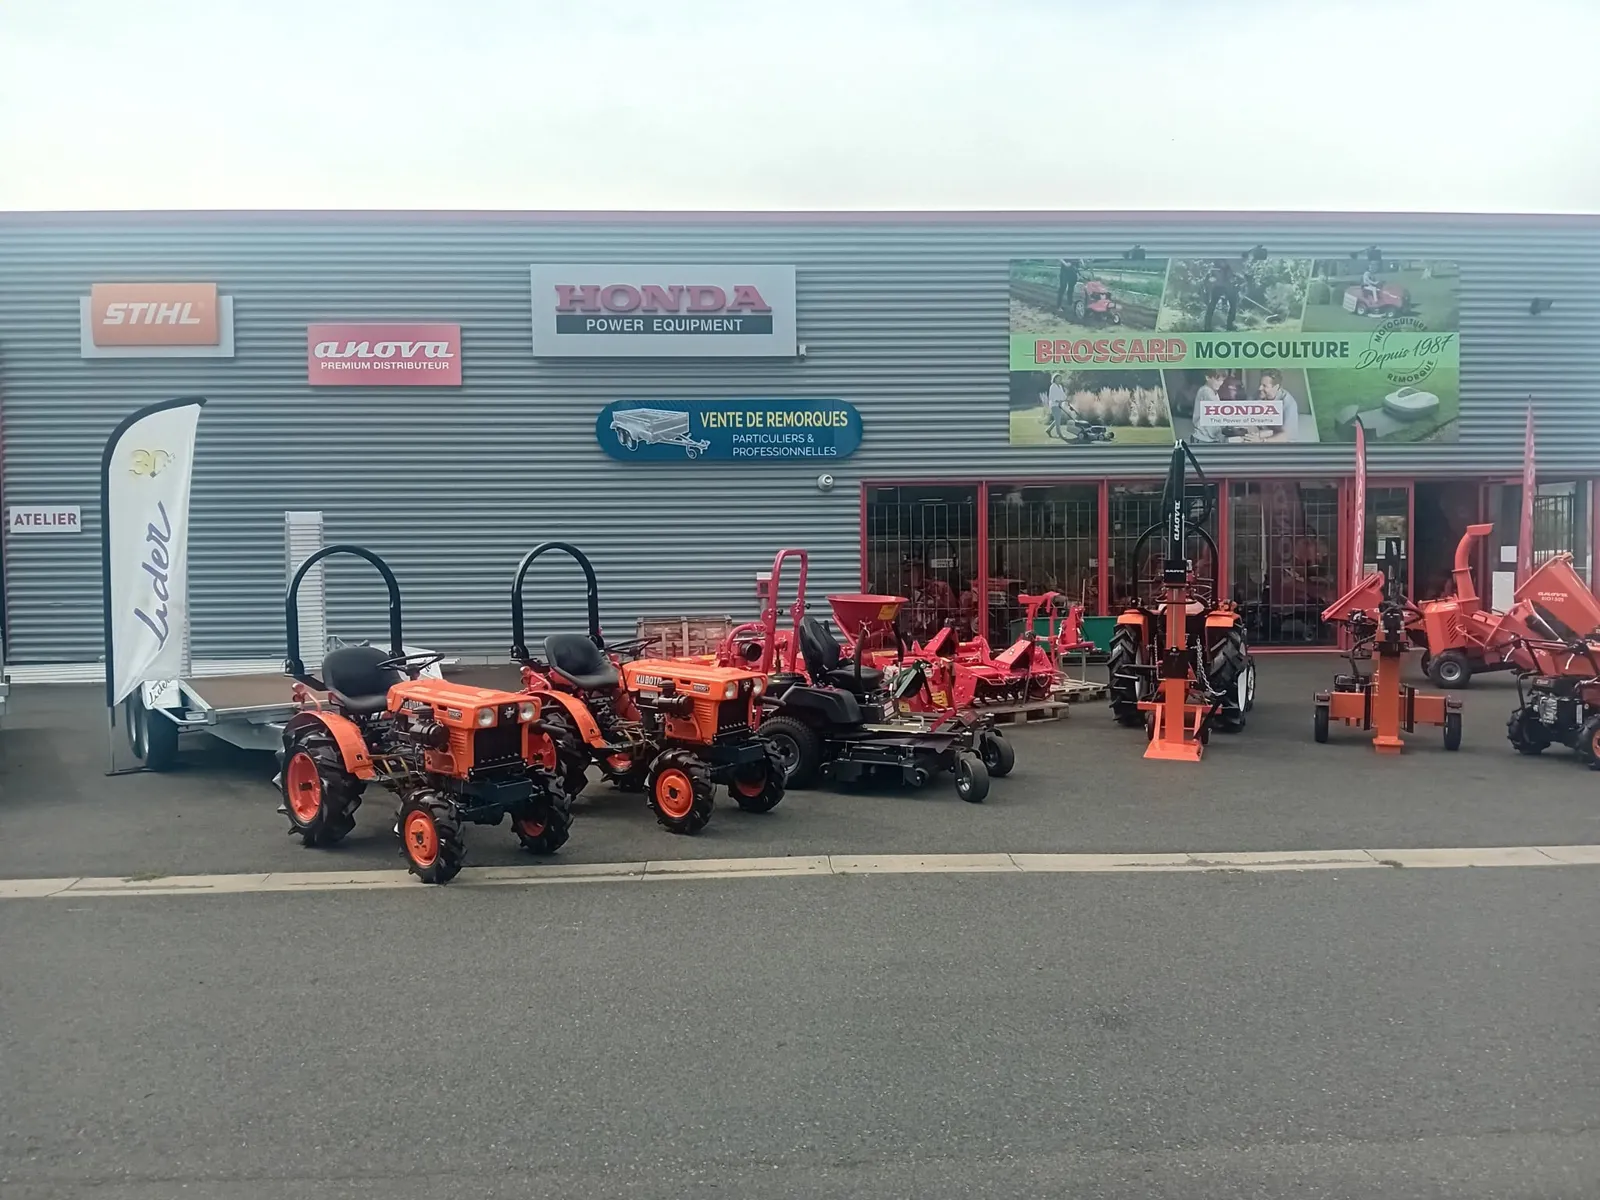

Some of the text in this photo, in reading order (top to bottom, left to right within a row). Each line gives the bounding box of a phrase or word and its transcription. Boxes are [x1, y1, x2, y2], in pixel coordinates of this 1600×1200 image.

[555, 284, 772, 312] HONDA
[102, 302, 200, 325] STIHL
[586, 319, 743, 332] POWER EQUIPMENT
[1374, 317, 1428, 343] MOTOCULTURE
[314, 340, 454, 358] anova
[1034, 338, 1349, 365] BROSSARD MOTOCULTURE
[1355, 333, 1454, 370] Depuis 1987
[320, 361, 450, 370] PREMIUM DISTRIBUTEUR
[1386, 360, 1434, 383] REMORQUE
[1204, 405, 1280, 415] HONDA
[700, 411, 848, 428] VENTE DE REMORQUES
[732, 434, 815, 444] PARTICULIERS &
[732, 447, 837, 456] PROFESSIONNELLES
[13, 512, 77, 526] ATELIER
